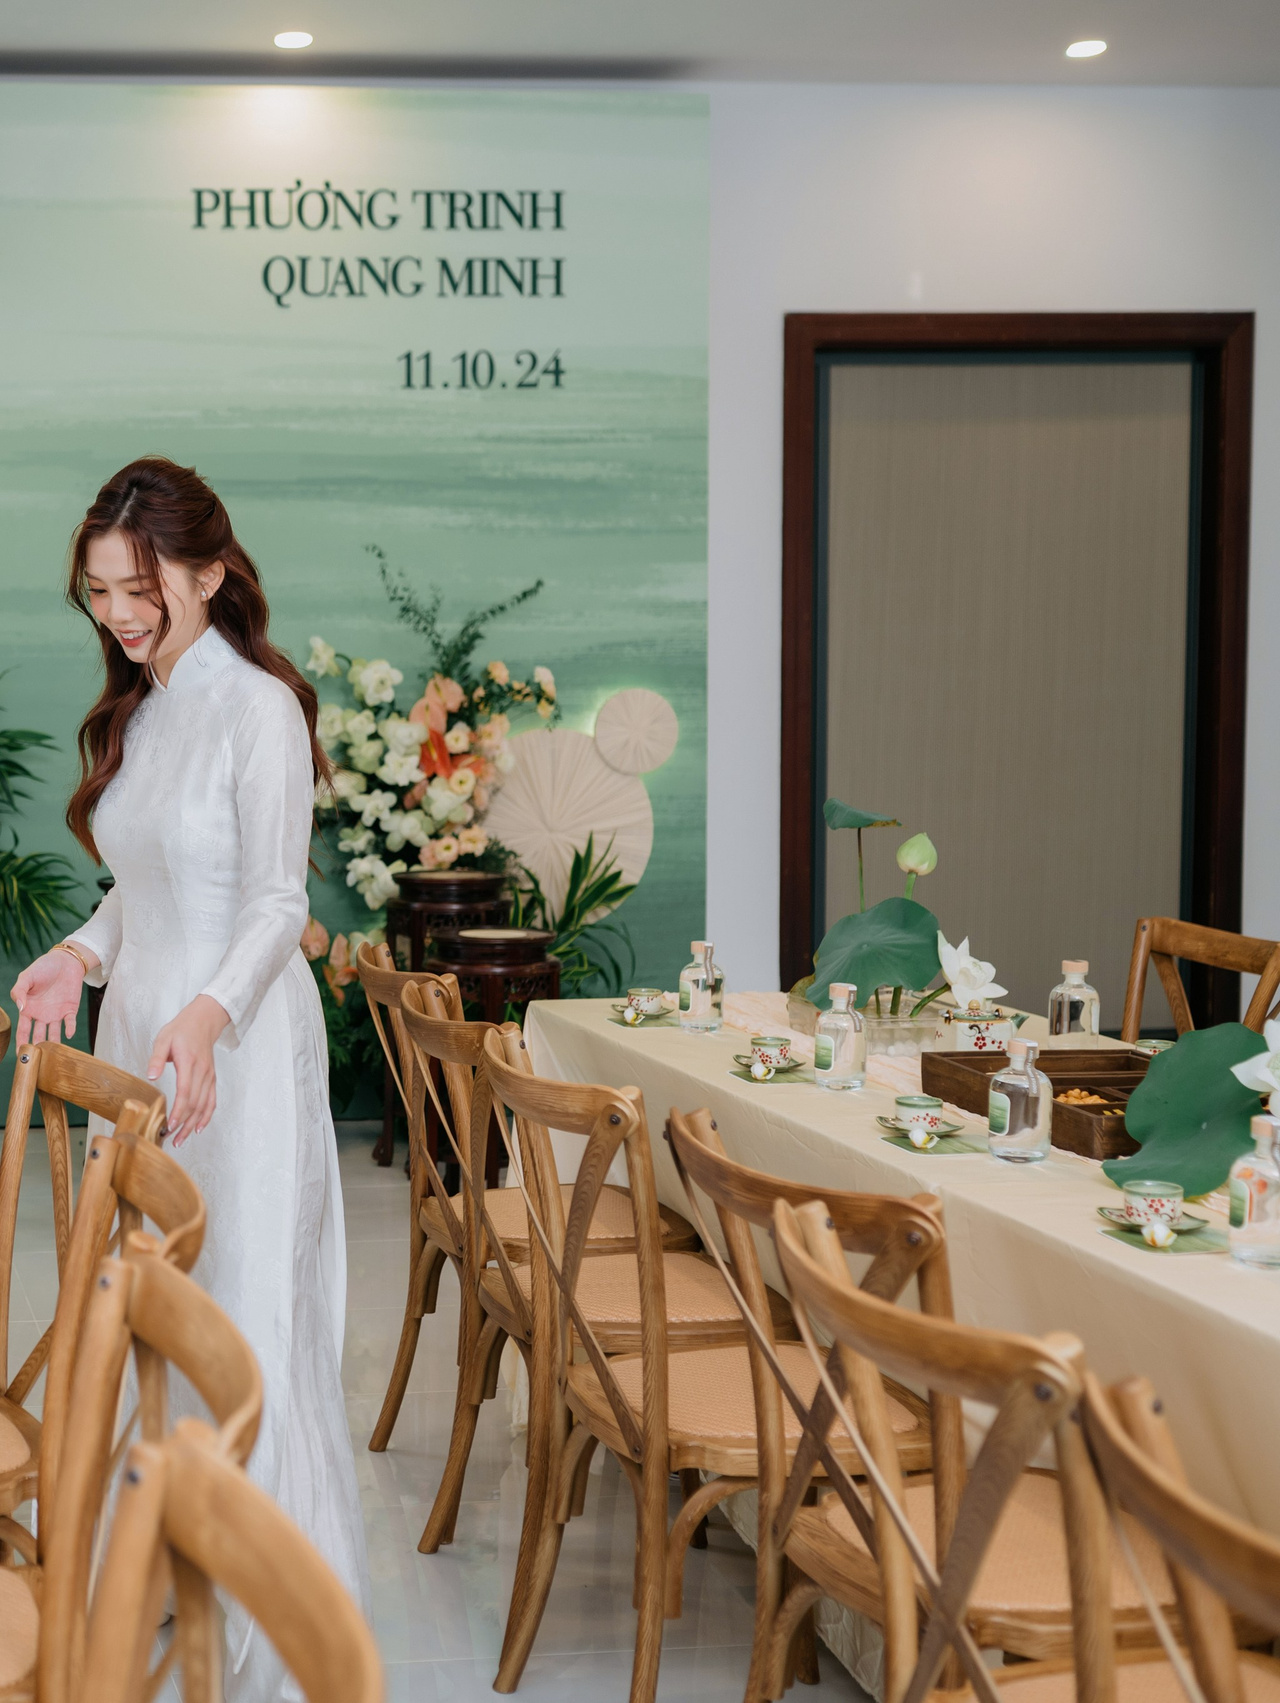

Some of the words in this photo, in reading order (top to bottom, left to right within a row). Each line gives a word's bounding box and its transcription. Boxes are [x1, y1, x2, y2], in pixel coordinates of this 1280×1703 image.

[192, 178, 401, 231] PHƯƠNG
[411, 189, 566, 231] TRINH
[261, 255, 425, 308] QUANG
[436, 256, 566, 298] MINH
[397, 348, 567, 390] 11.10.24
